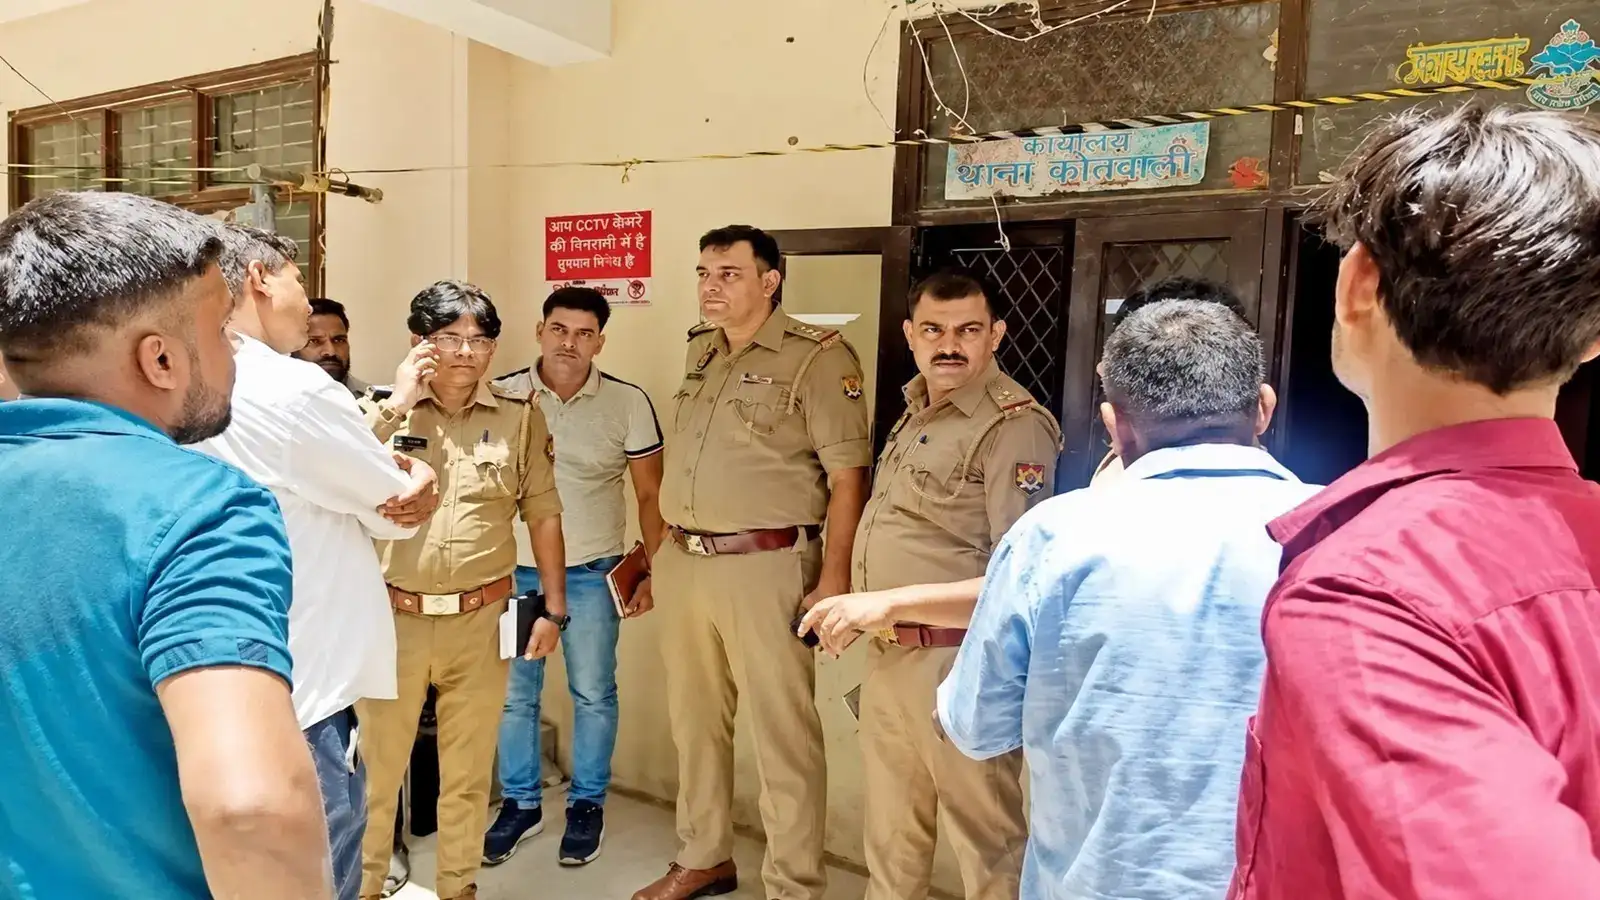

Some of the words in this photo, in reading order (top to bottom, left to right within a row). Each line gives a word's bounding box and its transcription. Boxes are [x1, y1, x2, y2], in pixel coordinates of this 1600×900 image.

[955, 161, 1037, 186] थाना
[1049, 143, 1197, 184] कोतवाली
[549, 221, 573, 233] आप
[576, 218, 609, 232] CCTV
[550, 236, 566, 253] की
[620, 232, 632, 249] में
[634, 231, 647, 250] है
